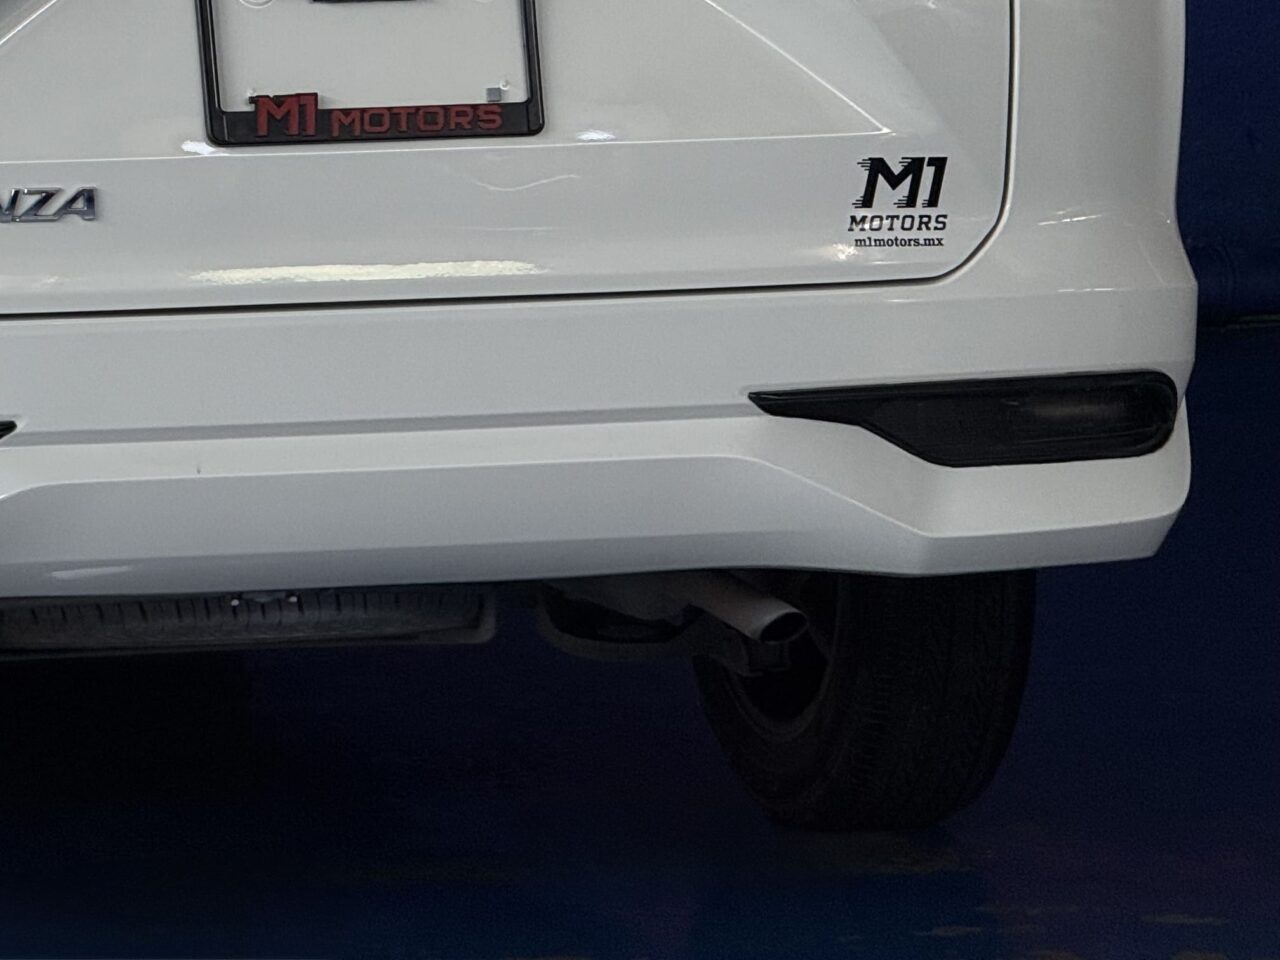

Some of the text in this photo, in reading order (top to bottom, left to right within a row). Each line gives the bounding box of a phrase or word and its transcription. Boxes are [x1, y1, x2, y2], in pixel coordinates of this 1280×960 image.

[256, 92, 505, 138] M1 MOTORS
[852, 157, 948, 209] M1
[848, 214, 948, 232] MOTORS
[854, 235, 944, 248] m1motors.mx
